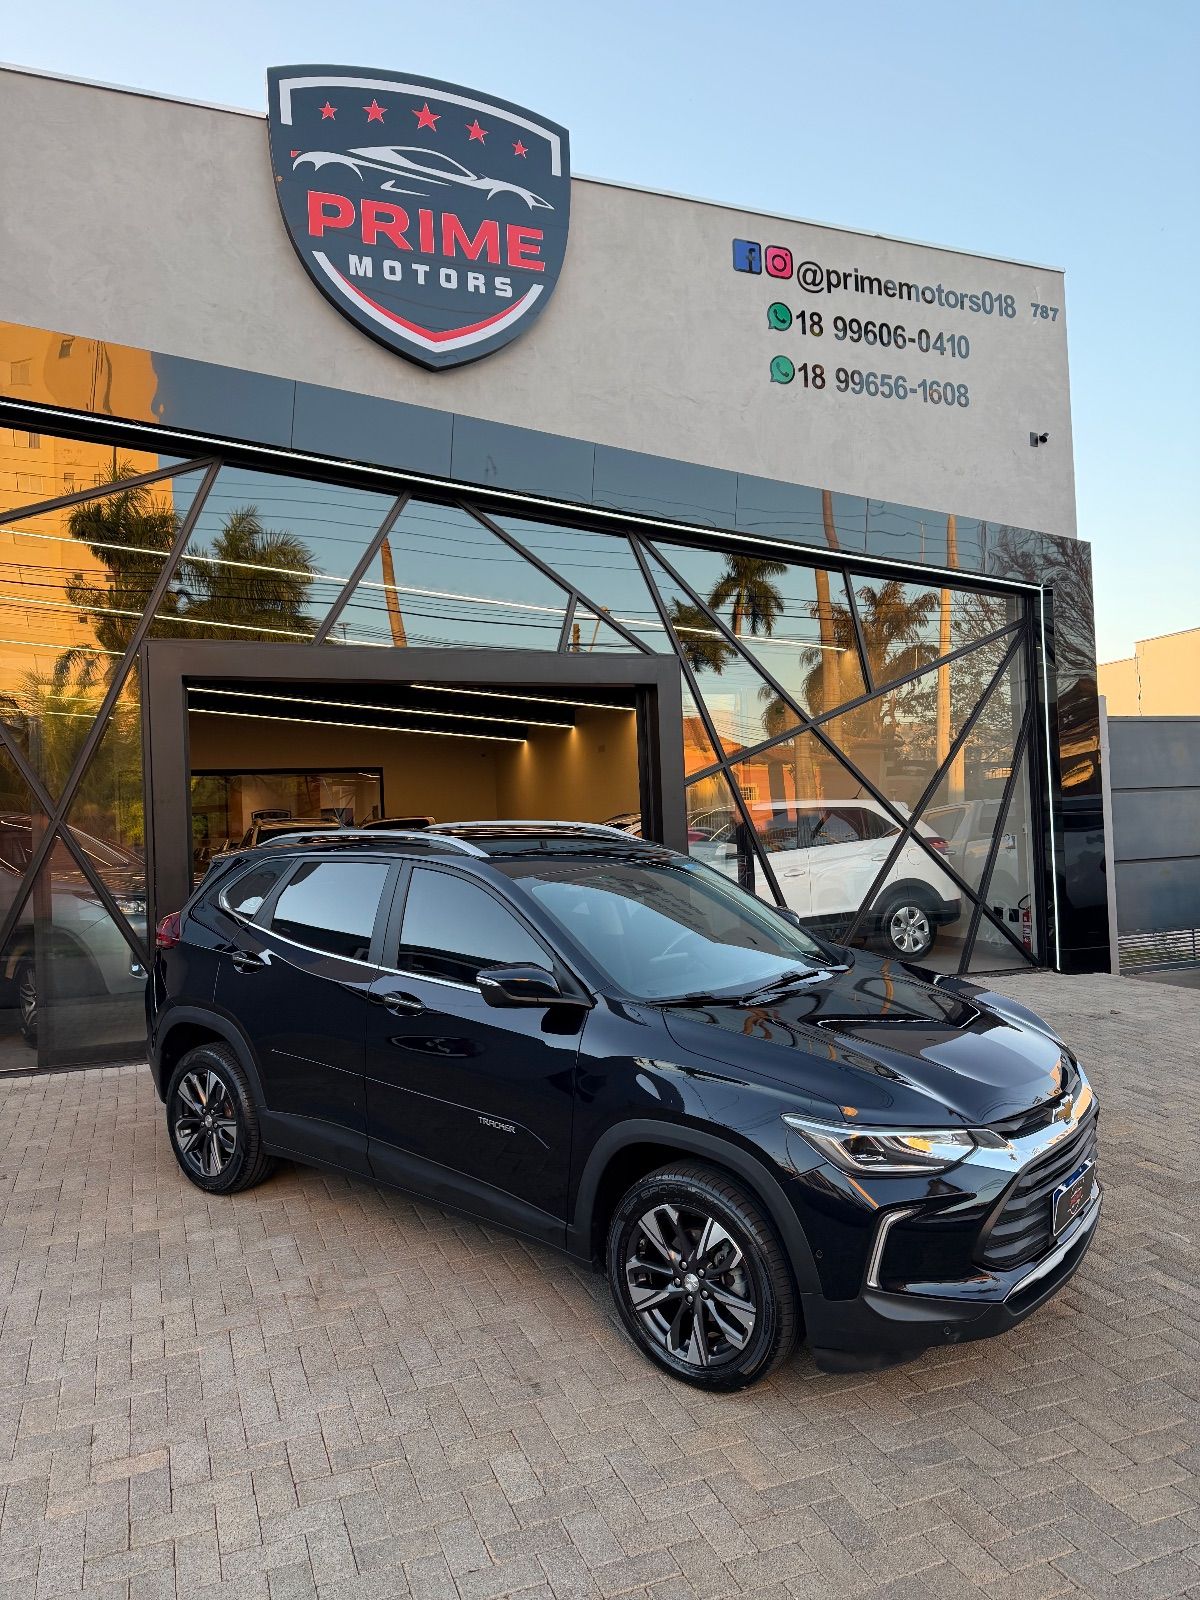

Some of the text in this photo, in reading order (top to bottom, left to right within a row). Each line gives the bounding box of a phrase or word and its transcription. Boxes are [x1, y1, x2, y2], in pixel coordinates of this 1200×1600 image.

[307, 190, 546, 272] PRIME
[348, 253, 513, 298] MOTORS
[796, 260, 1017, 319] @primemotors018
[795, 309, 970, 359] 18 99606-0410
[1030, 302, 1059, 321] 787
[797, 362, 970, 408] 18 99656-1608
[477, 1116, 516, 1134] TRACKER
